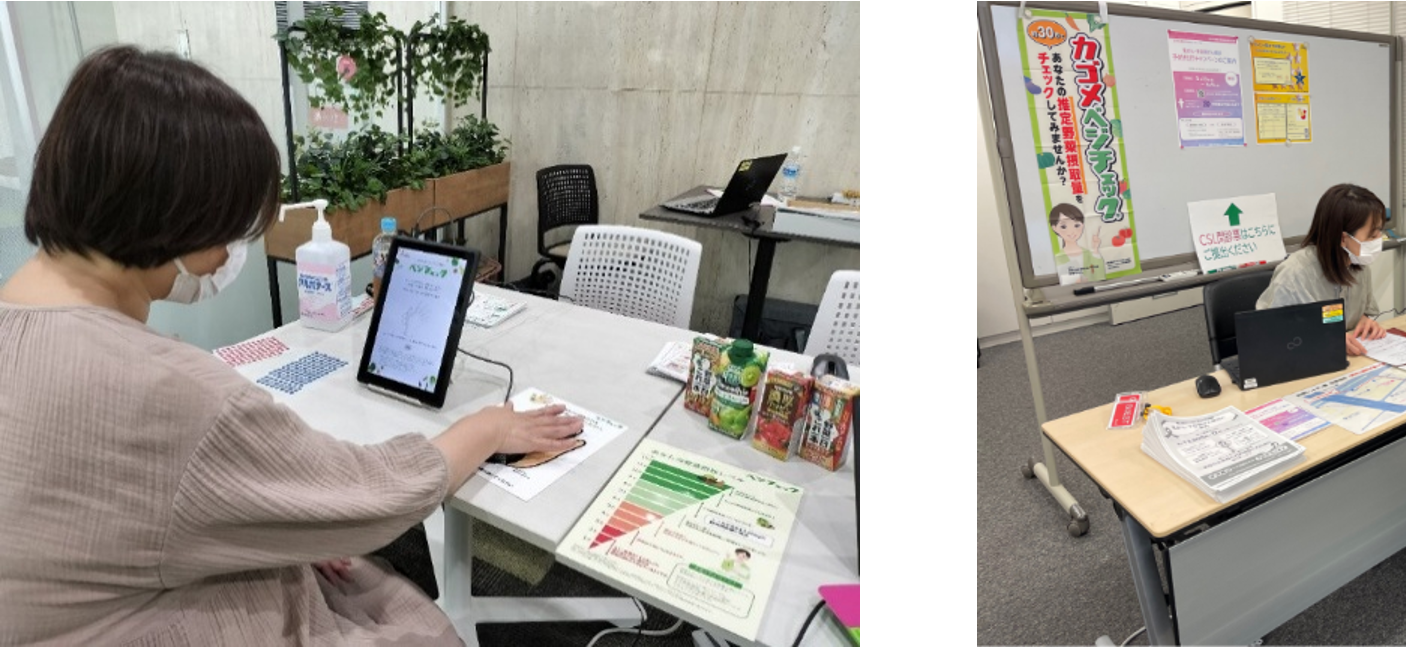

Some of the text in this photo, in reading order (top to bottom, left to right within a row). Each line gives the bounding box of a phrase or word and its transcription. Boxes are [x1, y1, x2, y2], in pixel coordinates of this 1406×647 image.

[1052, 52, 1084, 204] あなたの推定野菜摂取量を
[1203, 242, 1258, 261] ご提出ください
